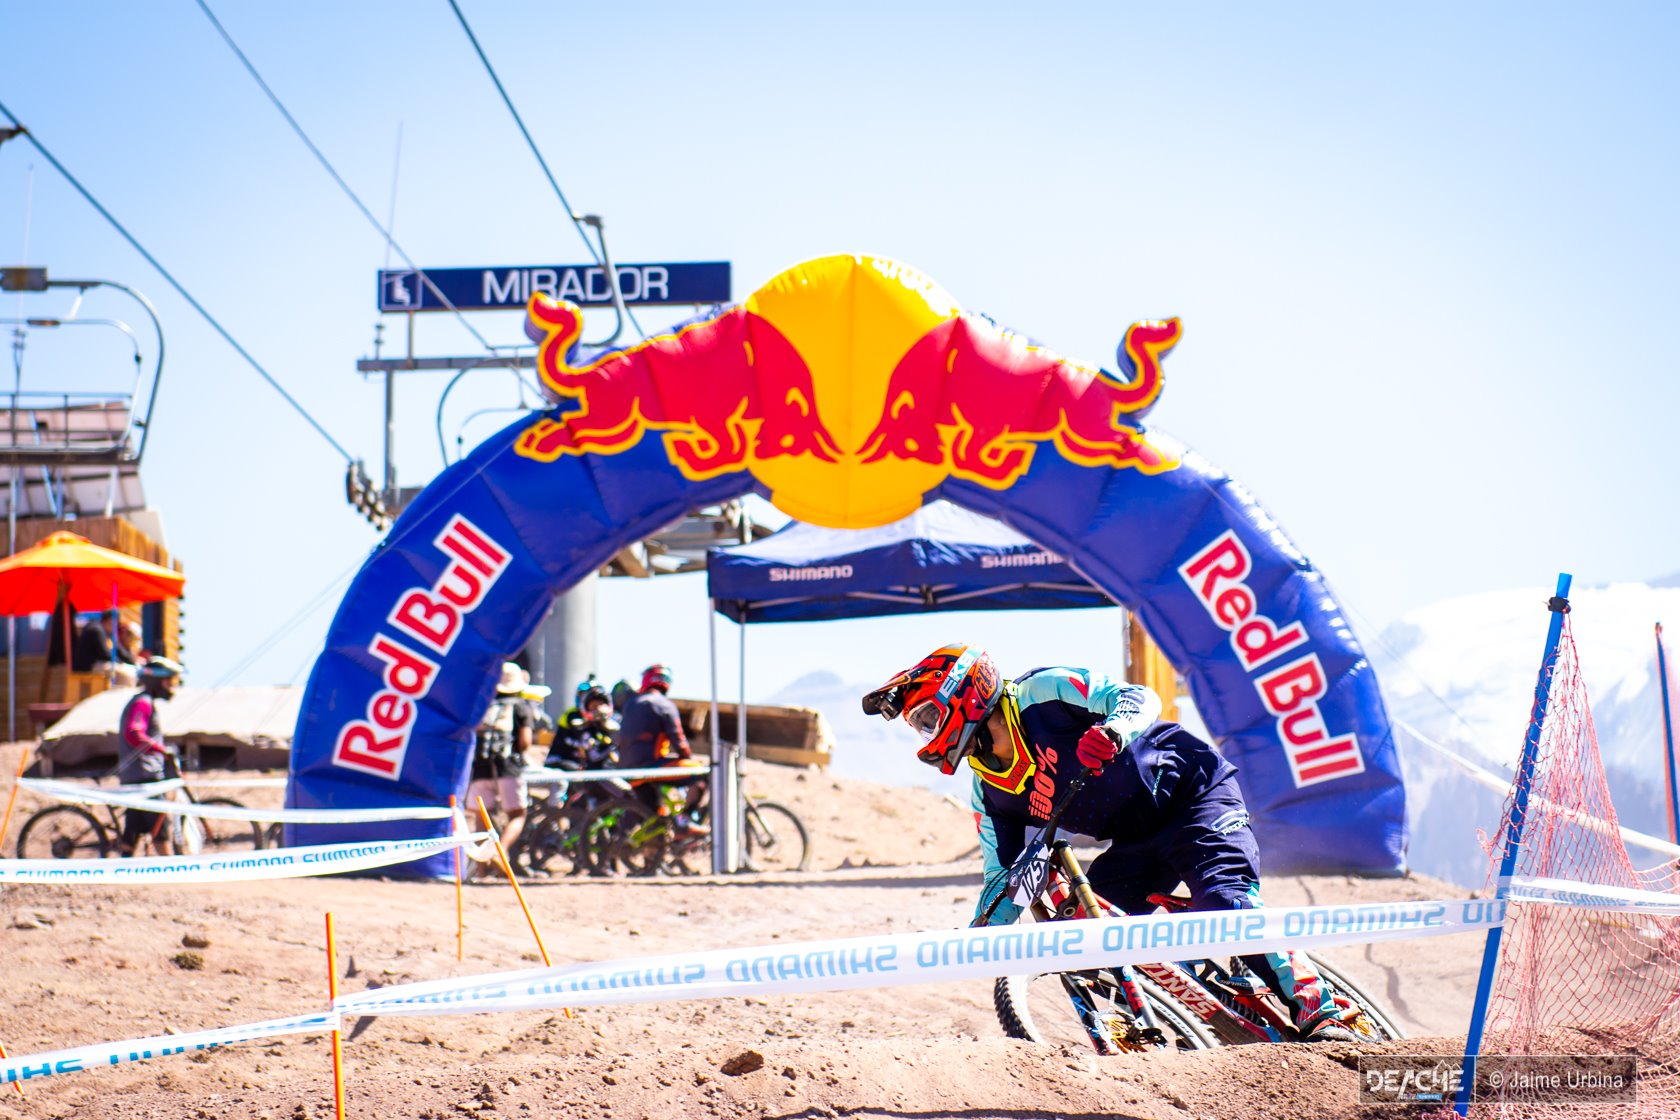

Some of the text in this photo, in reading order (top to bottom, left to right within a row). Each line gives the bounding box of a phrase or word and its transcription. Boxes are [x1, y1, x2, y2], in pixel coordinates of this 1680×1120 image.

[482, 266, 669, 304] MIRADOR
[769, 564, 853, 582] SHIMANO
[333, 633, 439, 780] Red
[388, 514, 512, 655] Bull
[1179, 529, 1364, 788] Red Bull
[1028, 743, 1058, 821] 100%
